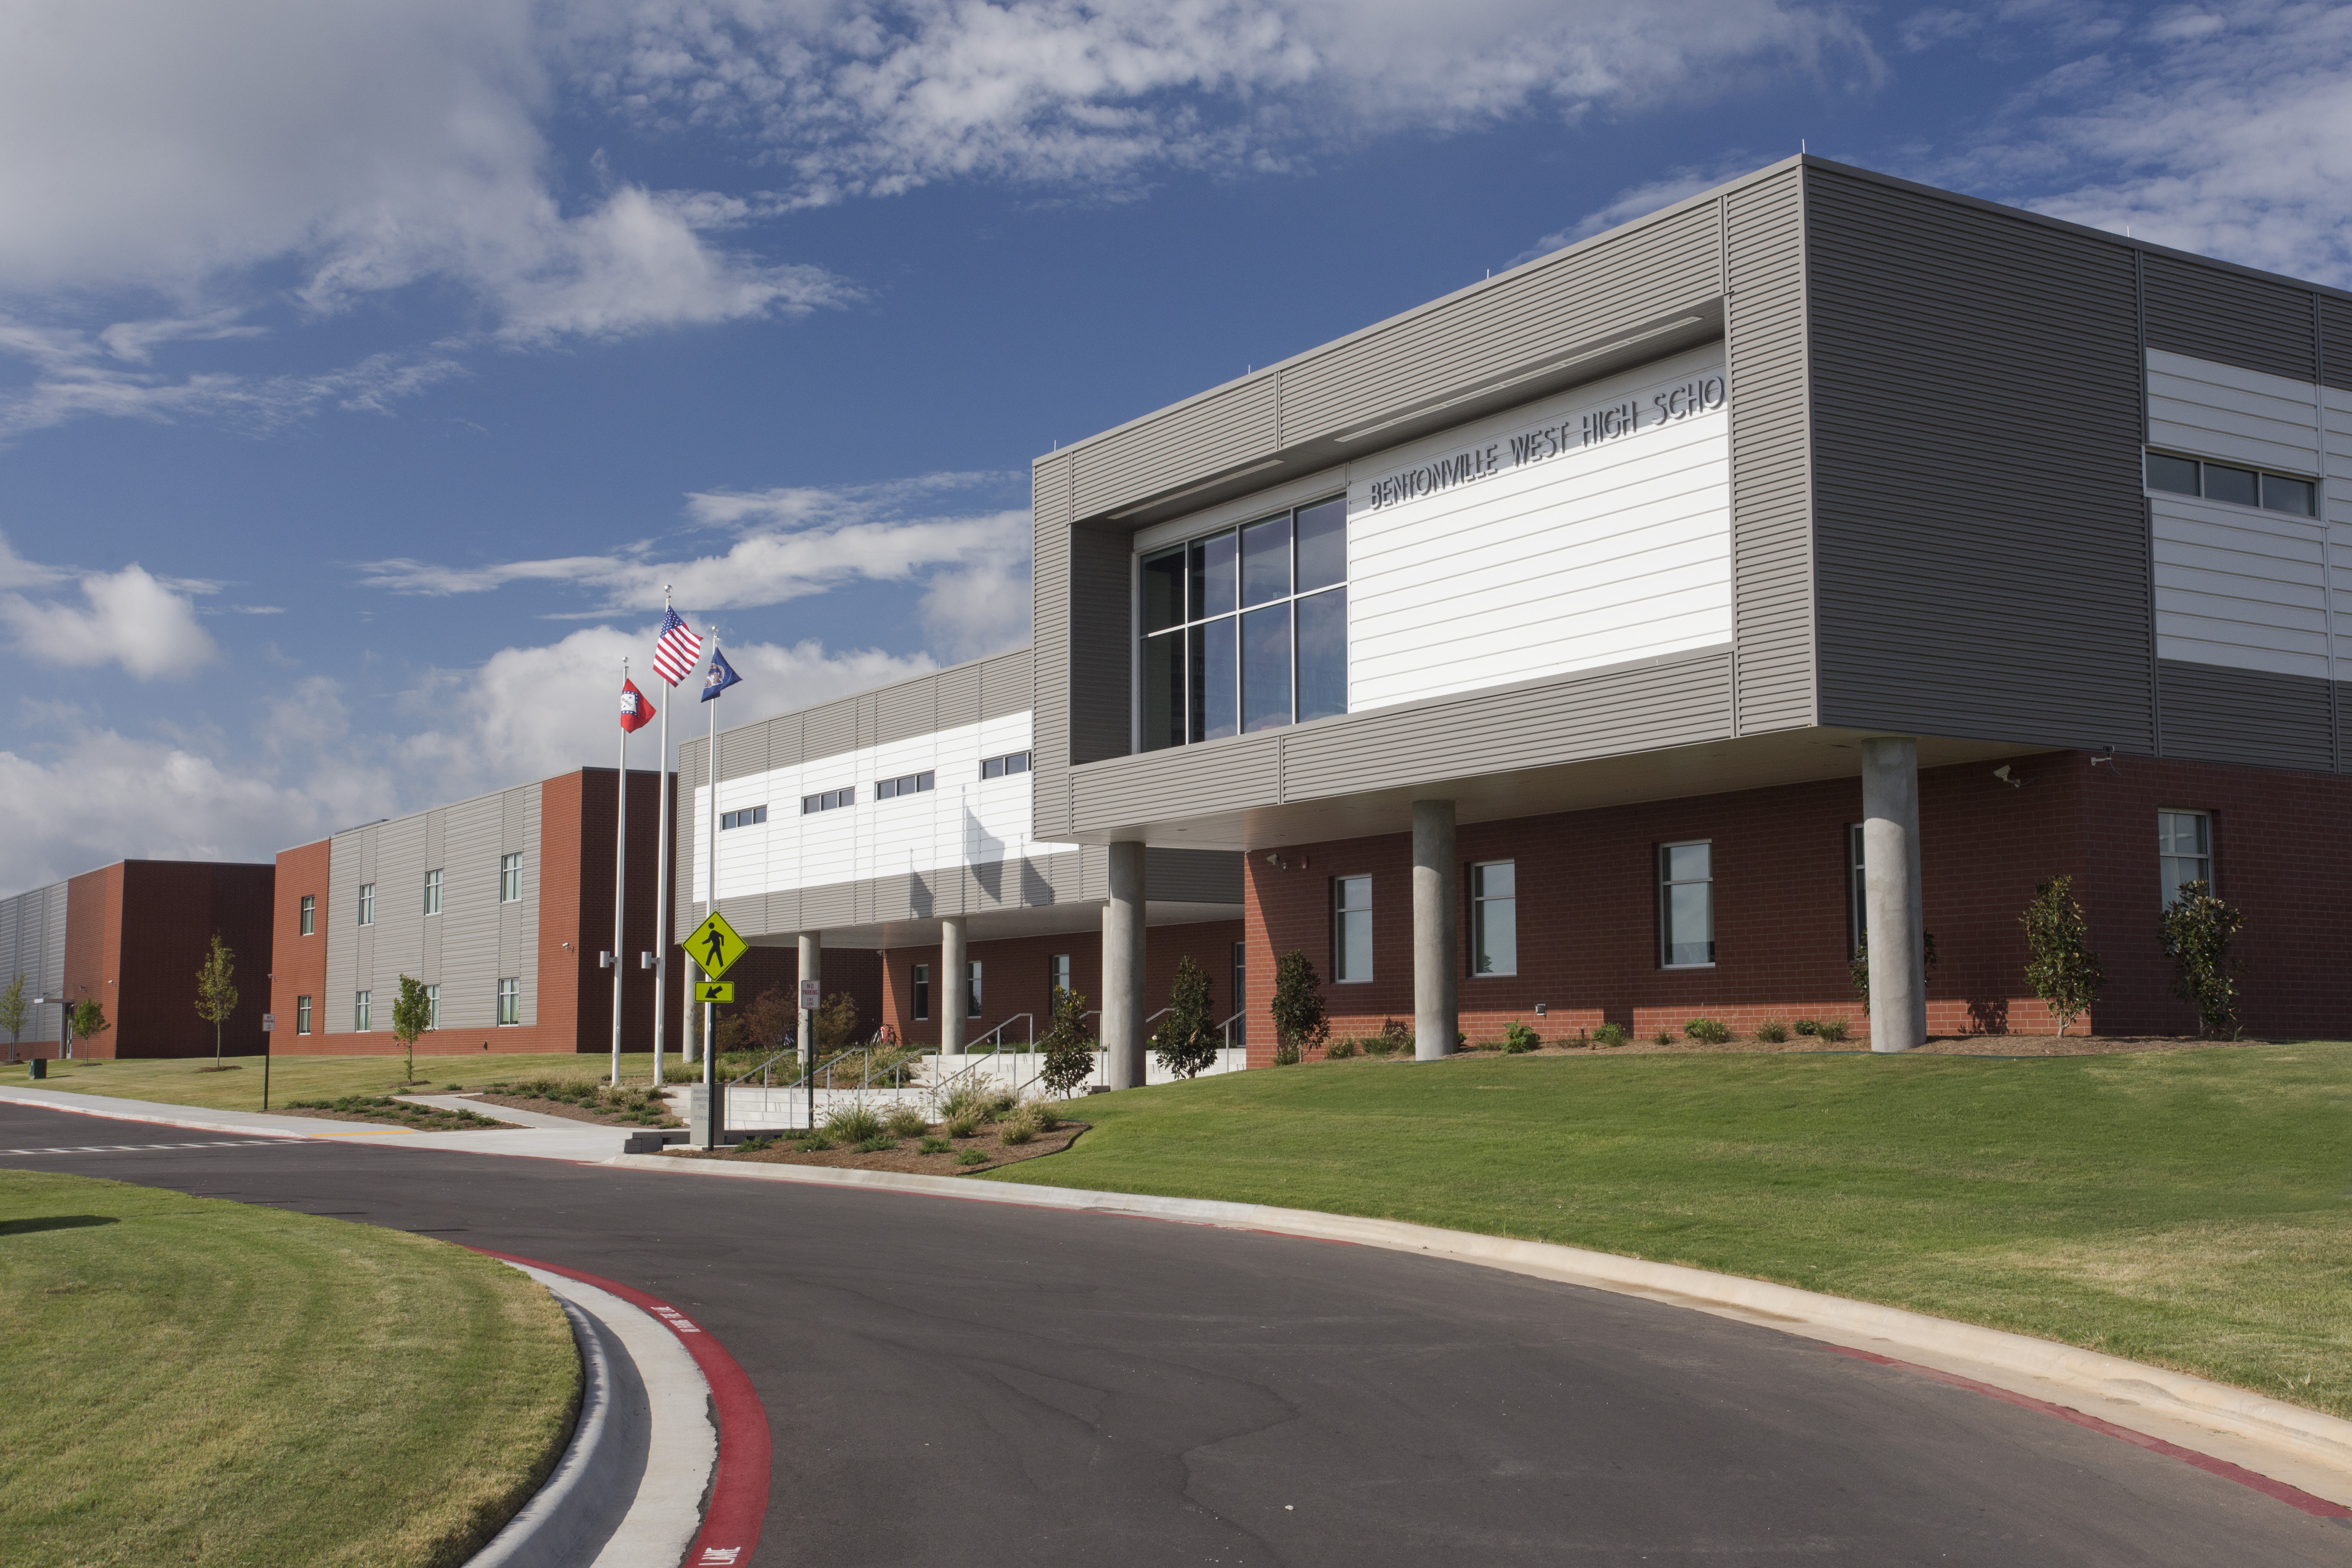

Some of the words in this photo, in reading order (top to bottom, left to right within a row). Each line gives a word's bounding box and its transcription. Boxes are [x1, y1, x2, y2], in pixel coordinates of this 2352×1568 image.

[1370, 444, 1498, 510] BENTONVILLE
[1510, 422, 1569, 468] WEST
[1581, 401, 1637, 447] HIGH
[698, 1547, 741, 1565] LANE
